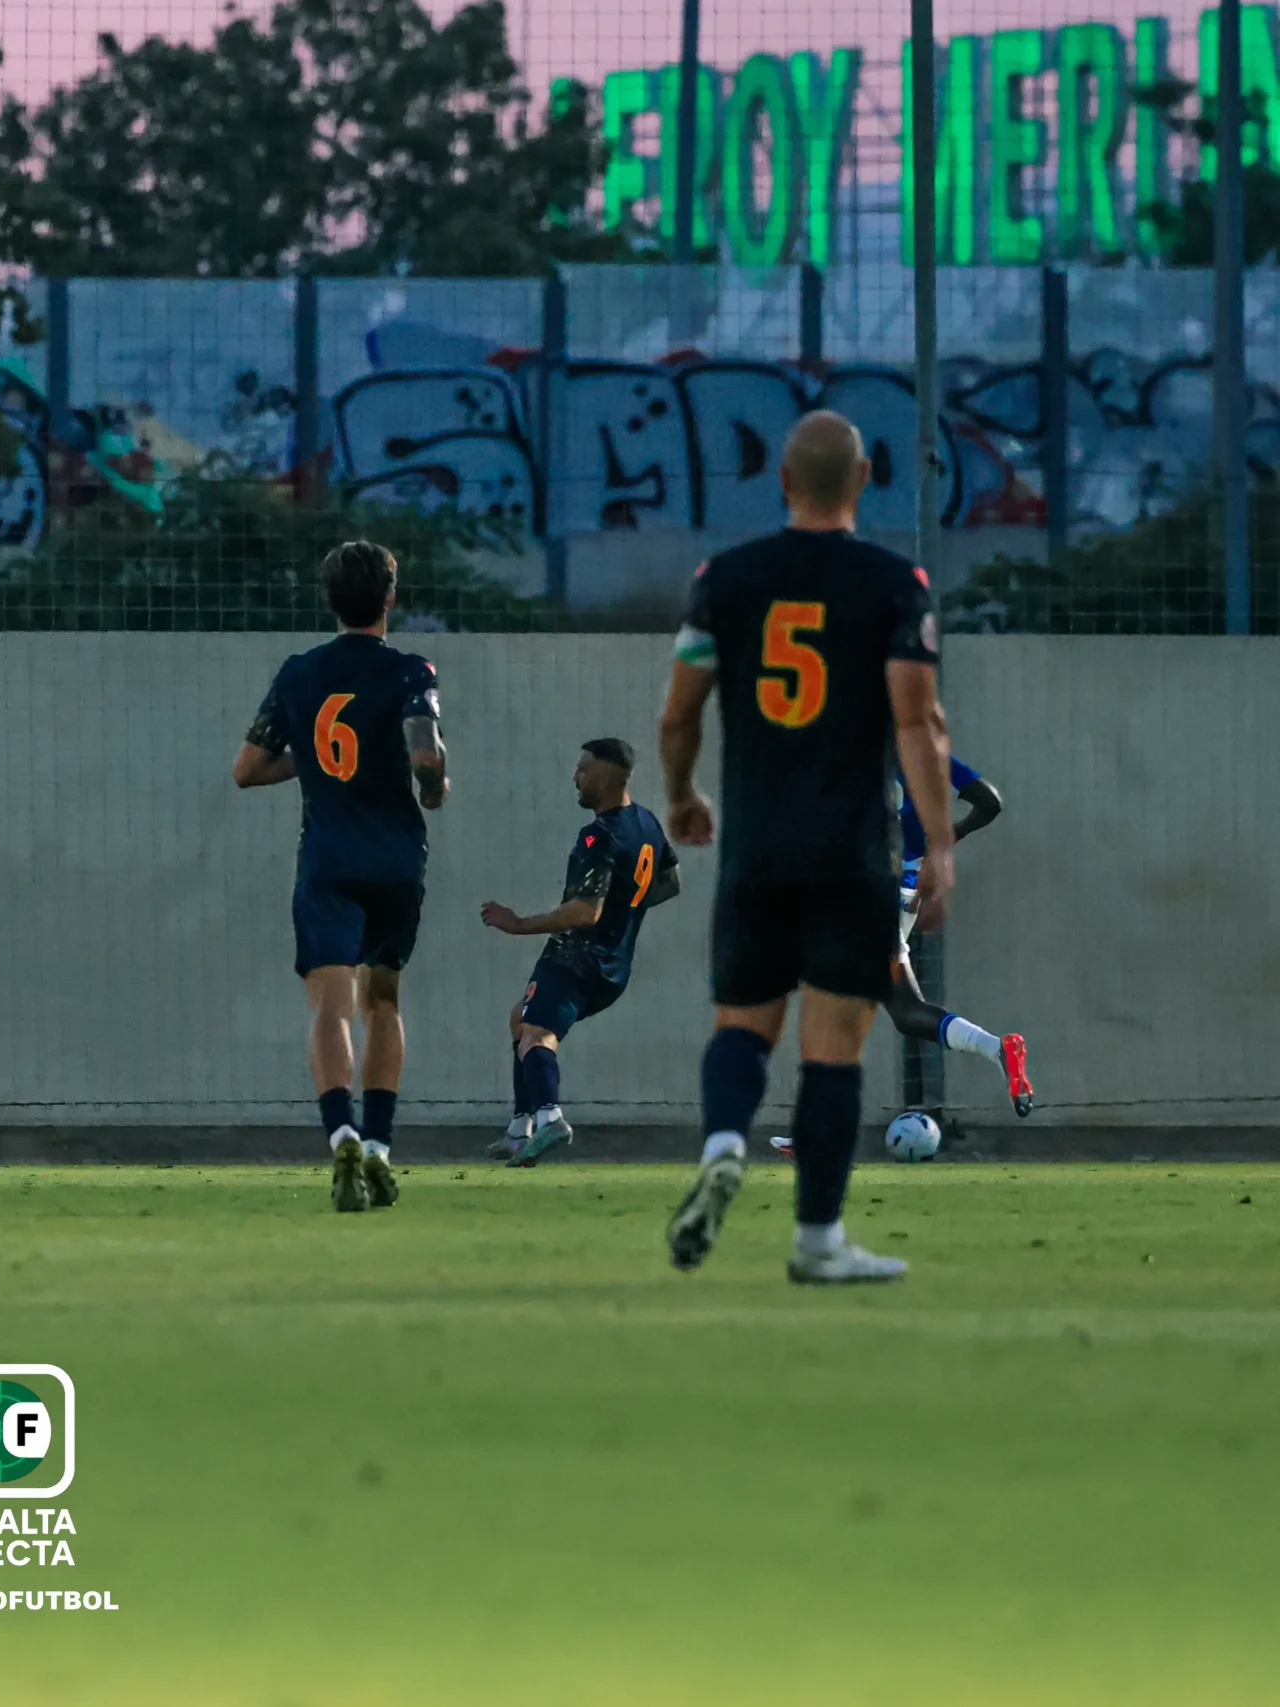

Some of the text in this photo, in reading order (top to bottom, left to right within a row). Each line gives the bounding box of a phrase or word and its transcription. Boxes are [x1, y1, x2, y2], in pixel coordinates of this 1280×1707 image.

[756, 601, 827, 729] 5
[314, 693, 359, 781] 6
[630, 844, 654, 907] 9
